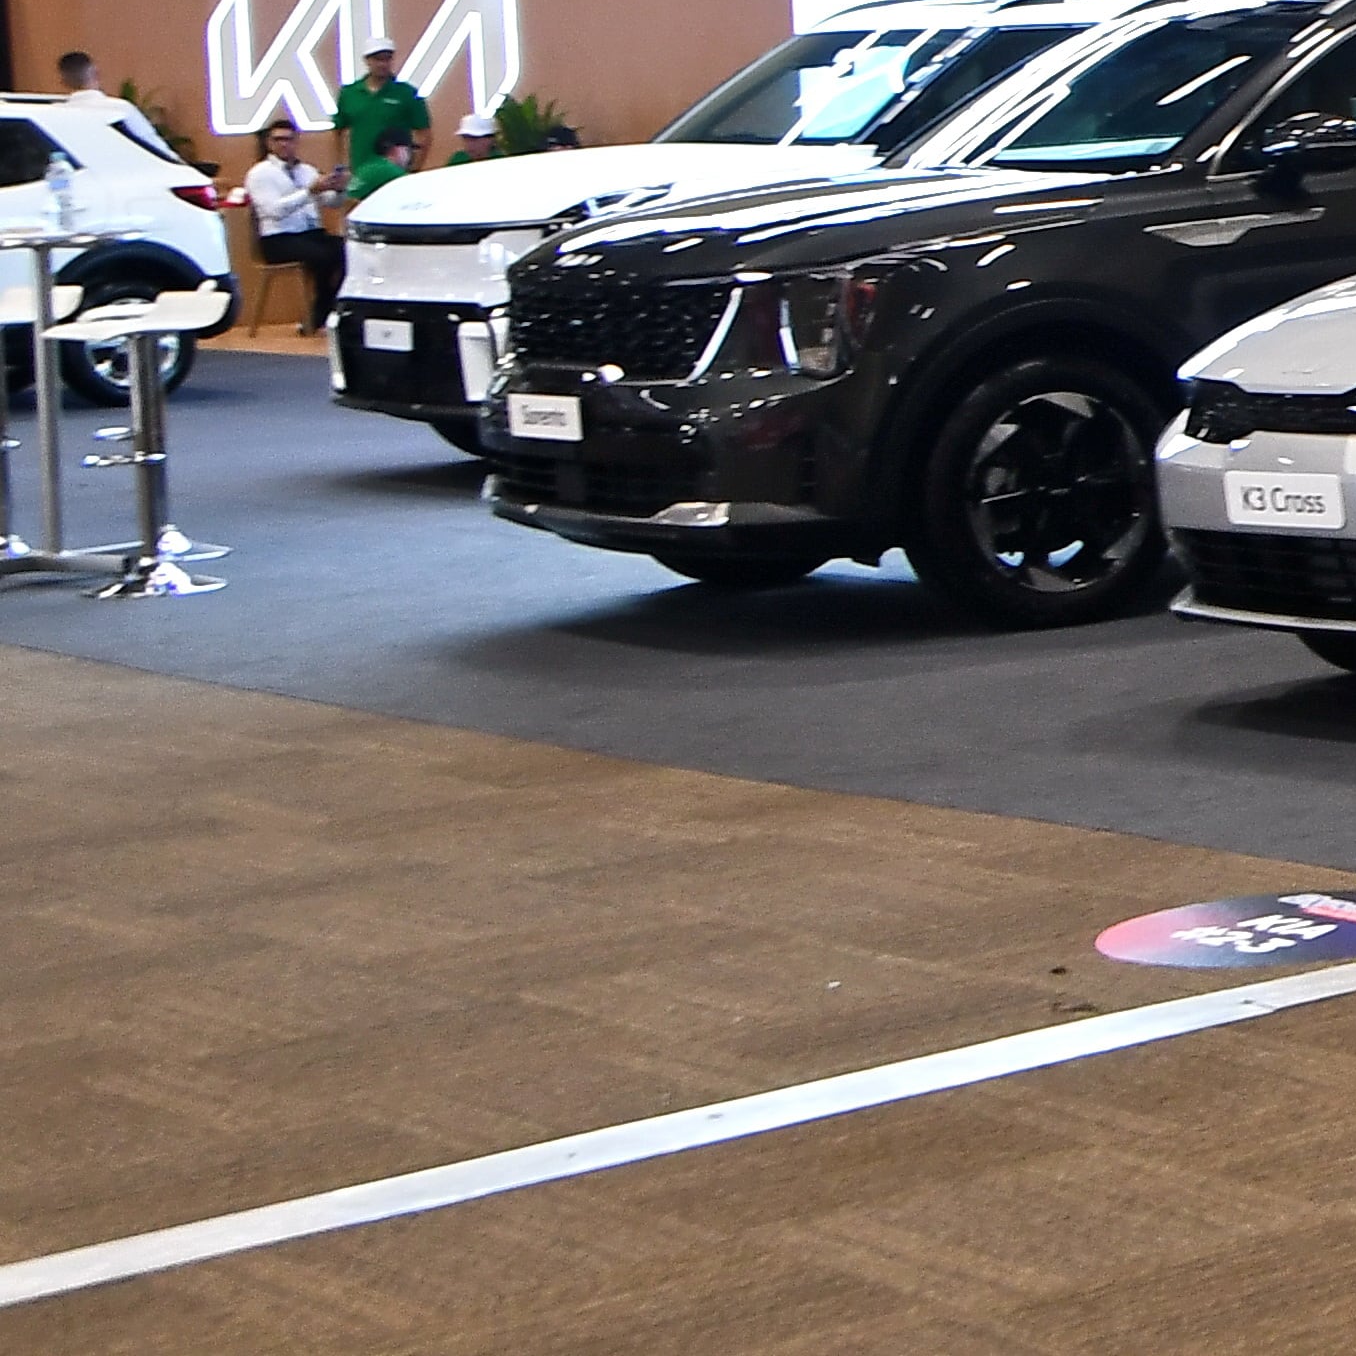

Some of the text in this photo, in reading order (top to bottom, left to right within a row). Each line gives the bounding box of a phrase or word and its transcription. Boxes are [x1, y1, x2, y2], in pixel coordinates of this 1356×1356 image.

[1241, 486, 1325, 514] K3 Cross
[1236, 914, 1338, 940] KIA
